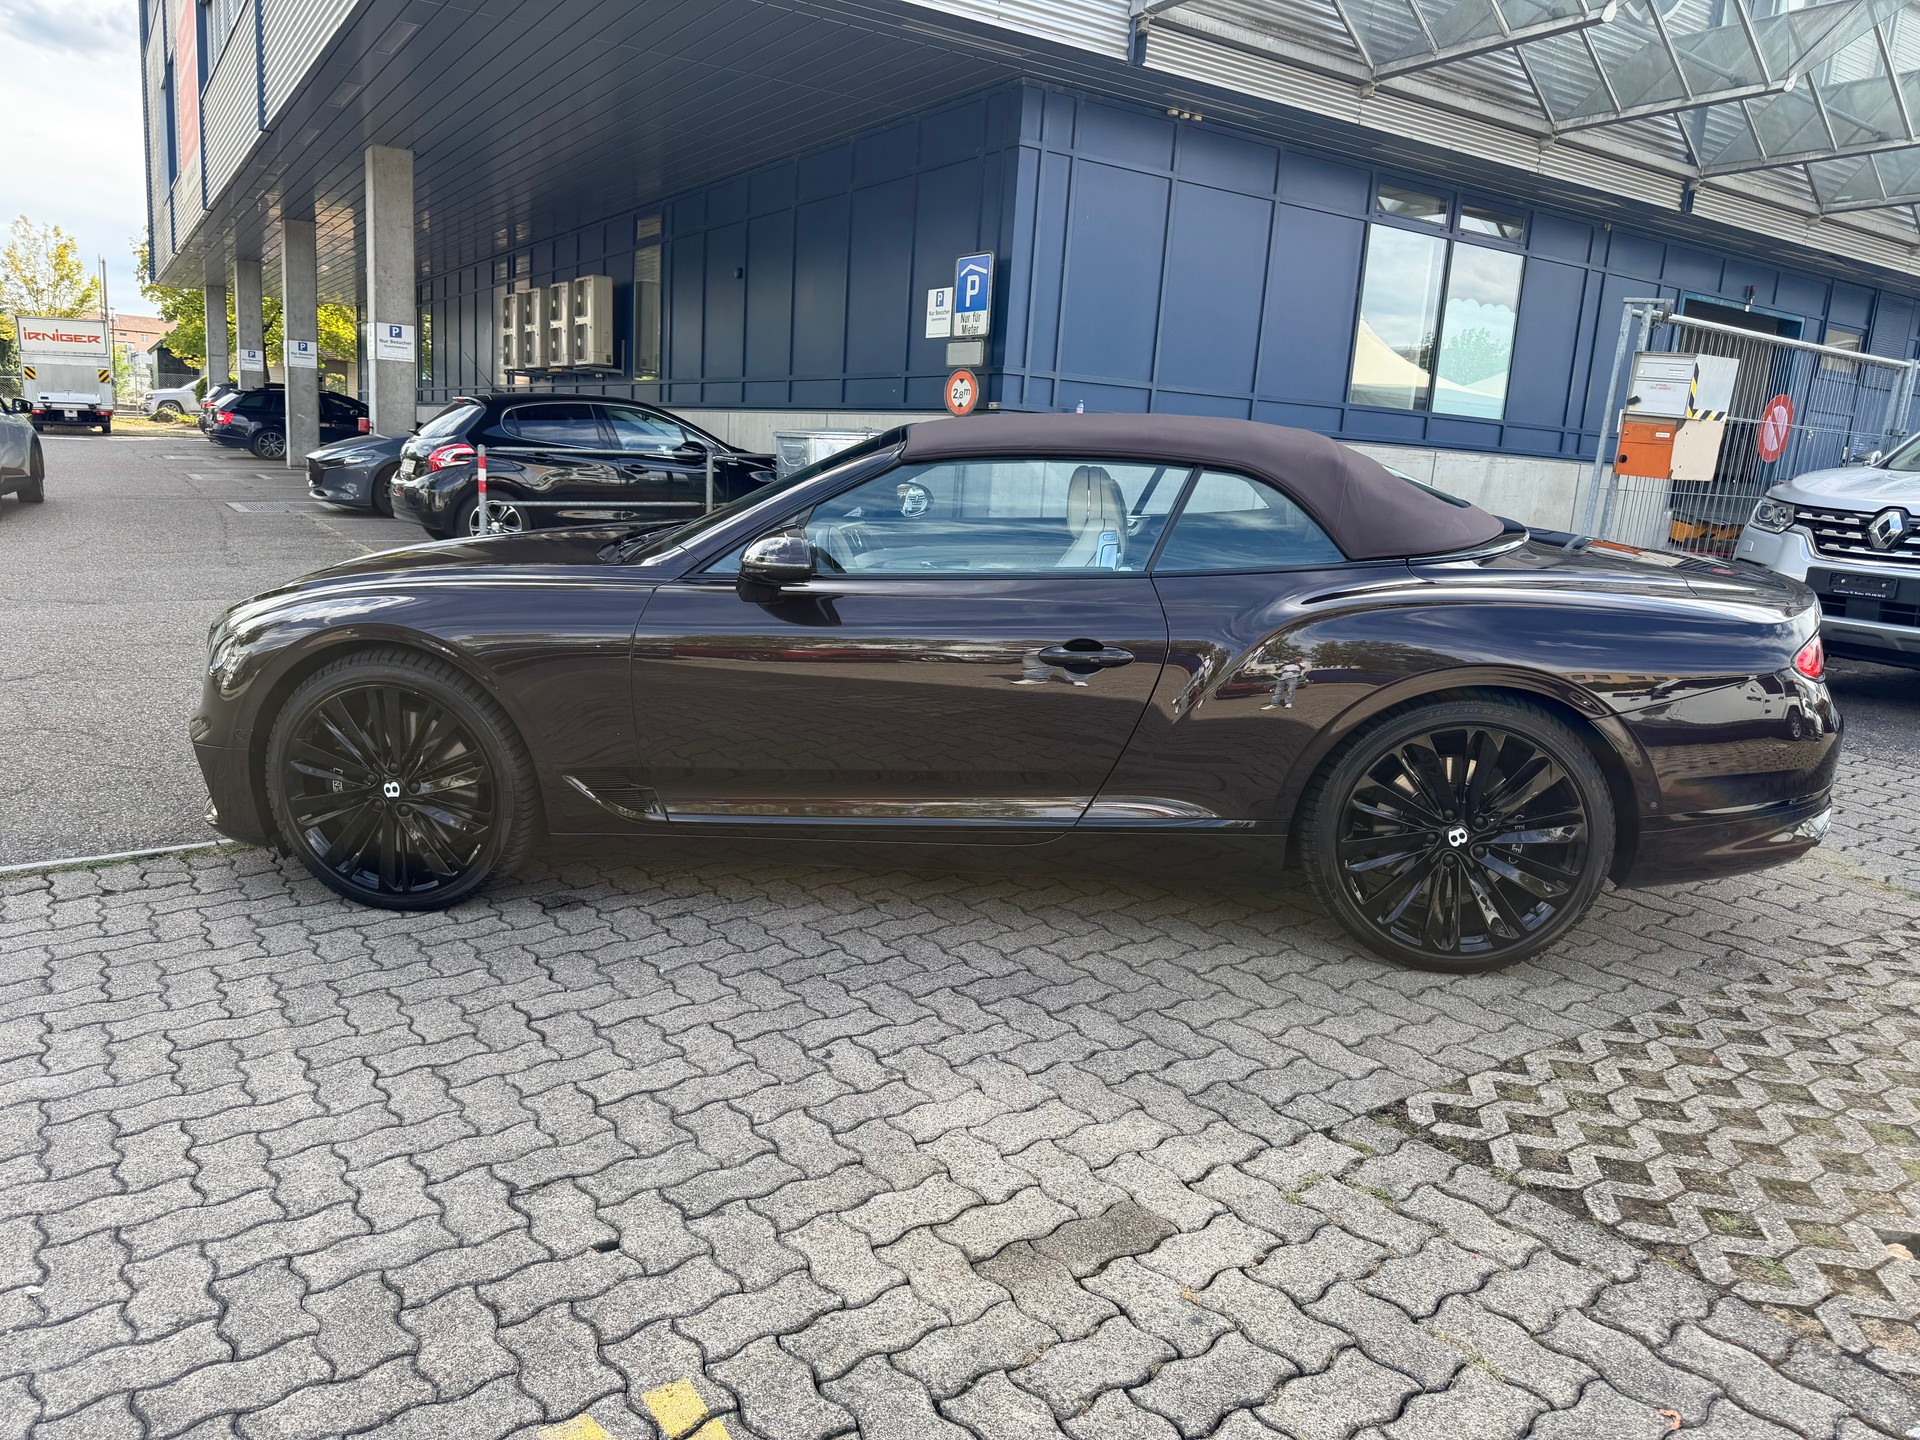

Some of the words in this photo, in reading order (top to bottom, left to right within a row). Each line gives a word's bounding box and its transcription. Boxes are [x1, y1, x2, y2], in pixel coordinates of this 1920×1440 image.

[965, 275, 980, 307] P
[960, 313, 971, 324] Nur
[972, 312, 981, 323] für
[392, 326, 400, 337] P
[961, 324, 979, 335] Mieter
